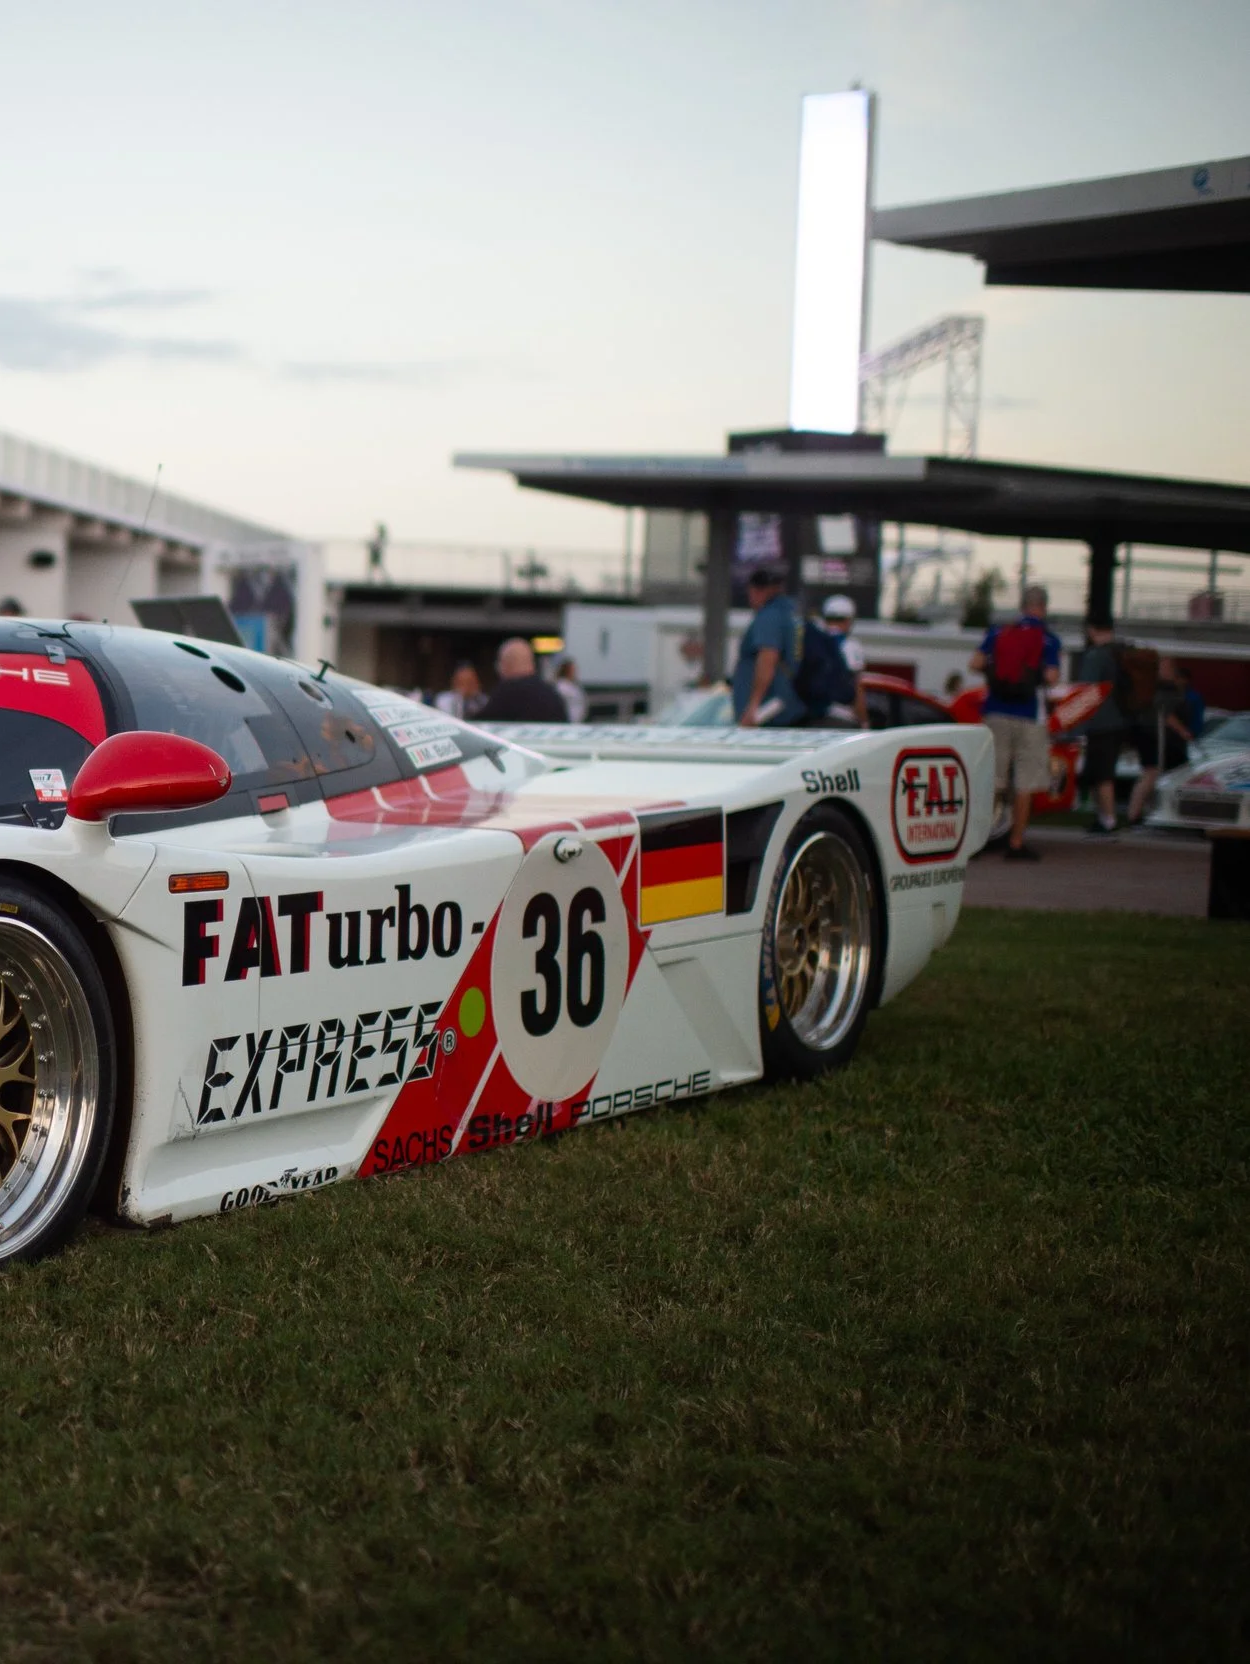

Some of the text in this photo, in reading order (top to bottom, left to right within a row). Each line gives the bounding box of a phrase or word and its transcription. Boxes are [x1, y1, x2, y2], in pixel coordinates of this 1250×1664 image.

[801, 768, 860, 792] Shell
[520, 886, 606, 1037] 36
[570, 1070, 711, 1122] PORSCHE
[373, 1124, 453, 1175] SACHS
[468, 1102, 553, 1150] Shell
